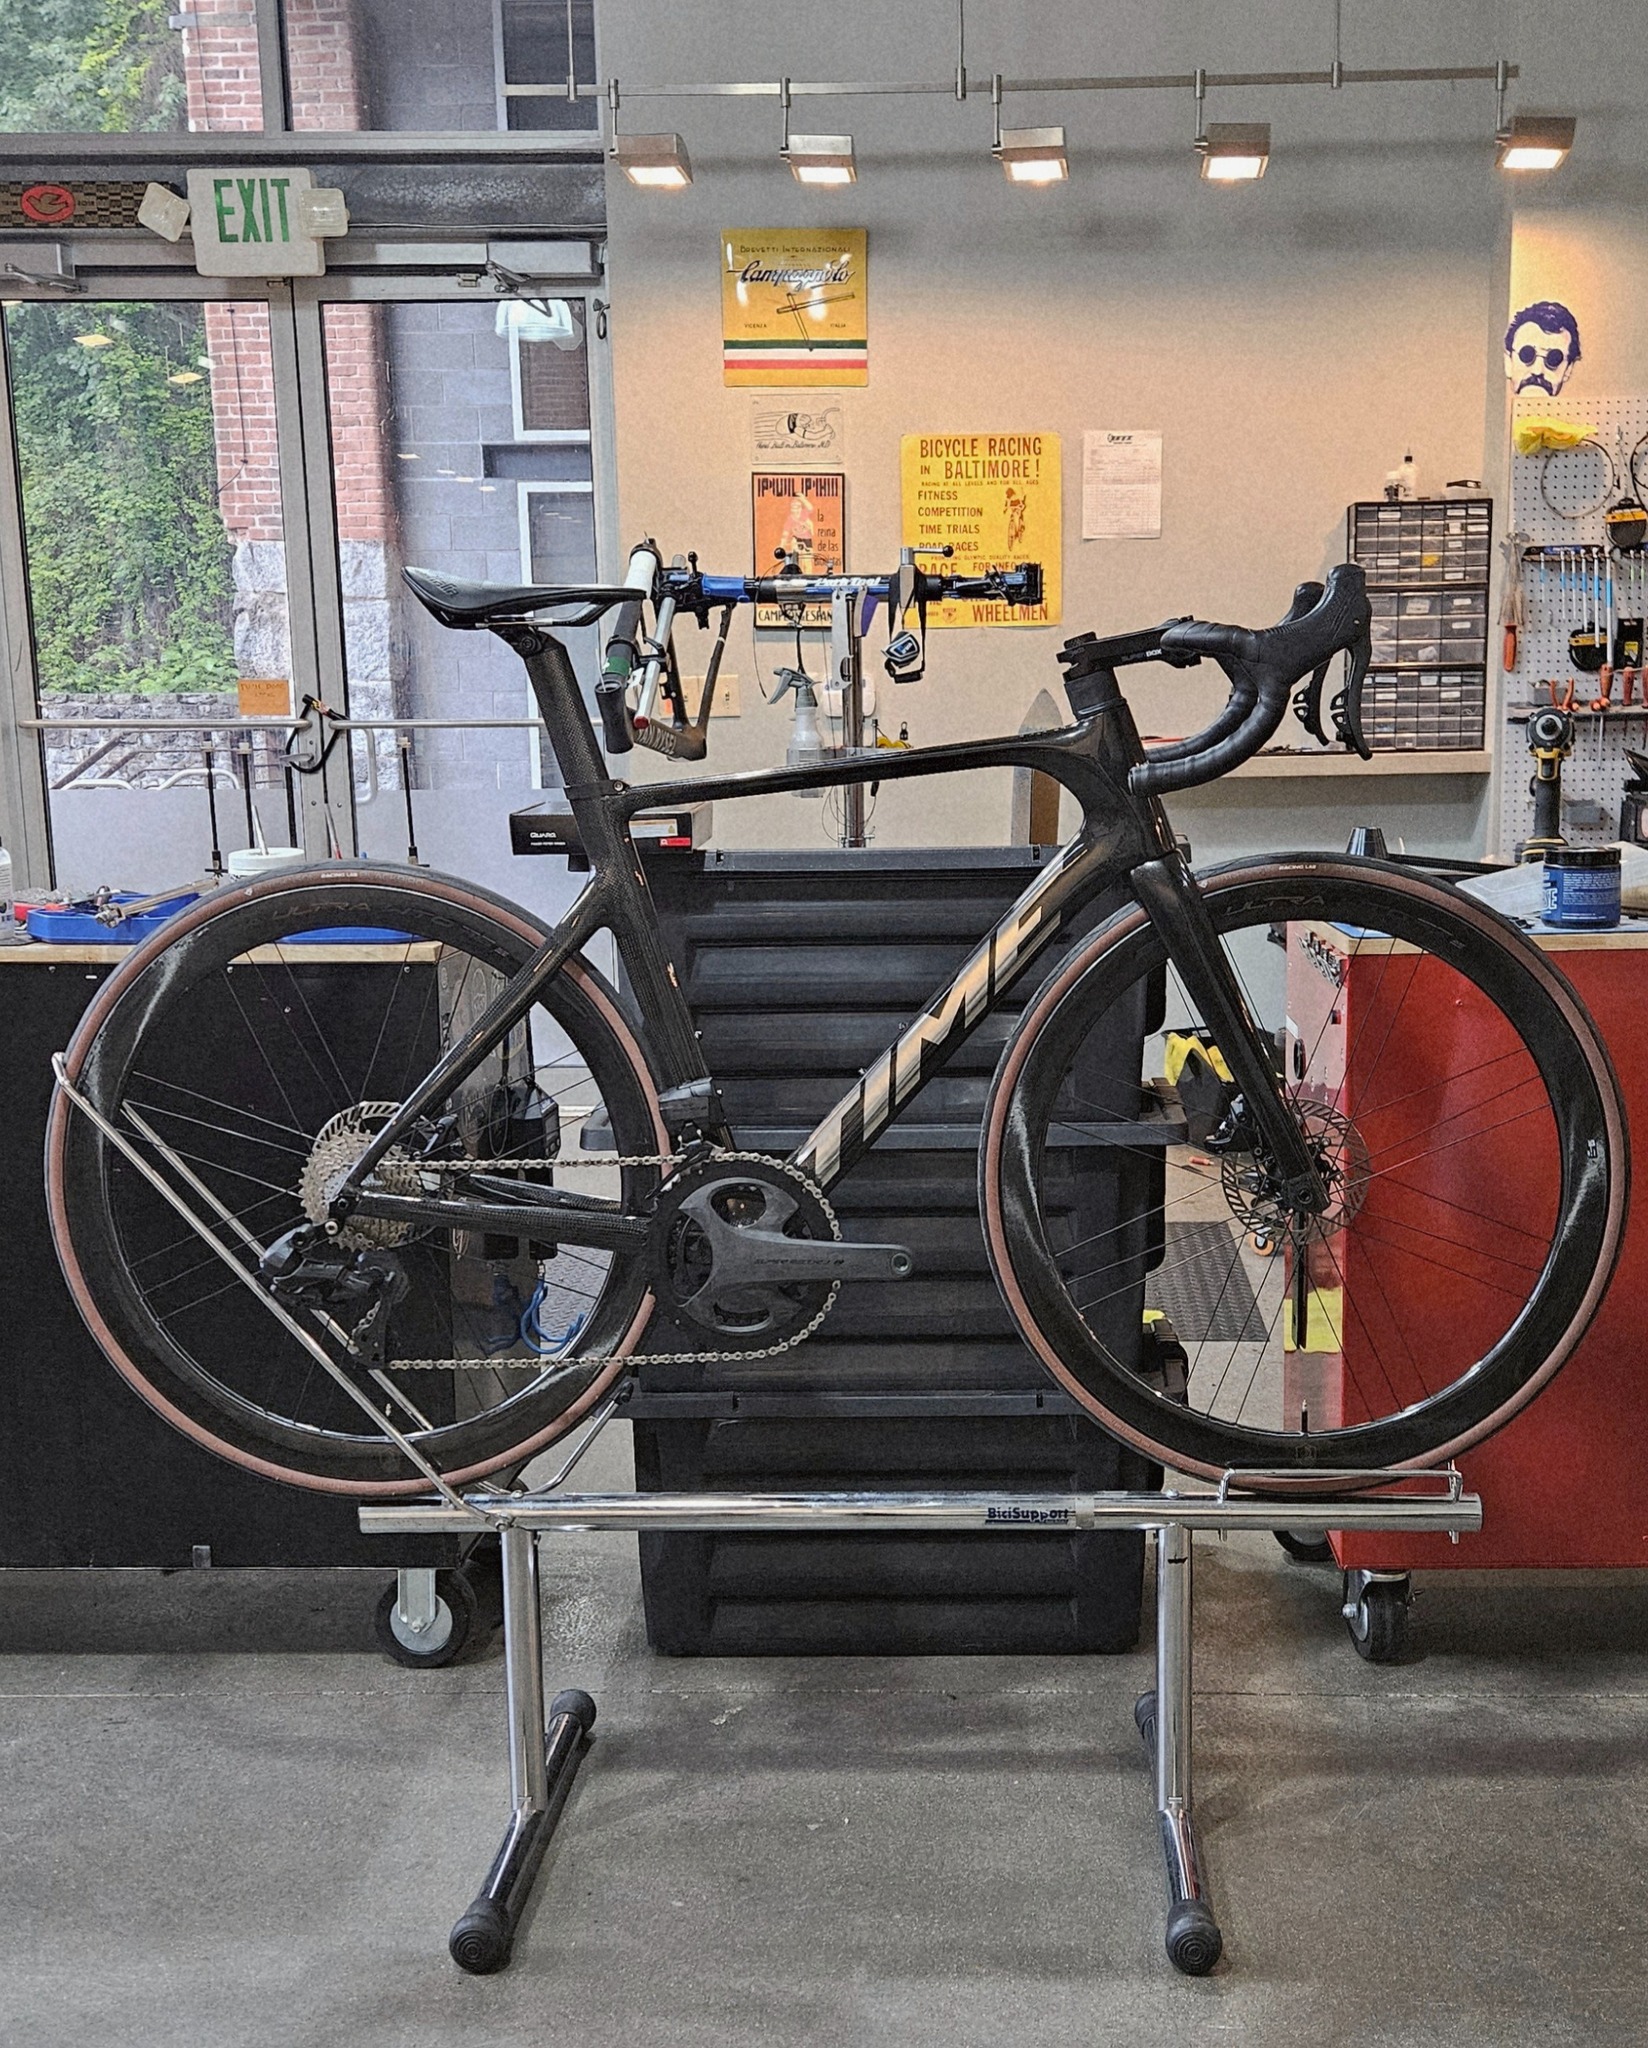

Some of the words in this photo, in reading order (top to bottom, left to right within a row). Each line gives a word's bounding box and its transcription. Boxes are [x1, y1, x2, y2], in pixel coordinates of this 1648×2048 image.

[213, 178, 290, 243] EXIT
[740, 245, 779, 253] BREVETTI
[727, 260, 856, 292] Campagnolo
[920, 438, 978, 458] BICYCLE
[988, 437, 1042, 457] RACING
[920, 465, 930, 475] IN
[918, 490, 958, 500] FITNESS
[918, 507, 983, 517] COMPETITION
[919, 524, 942, 534] TIME
[947, 524, 980, 534] TRIALS
[973, 563, 990, 571] FOR
[973, 604, 1048, 622] WHEELMEN
[987, 1507, 1069, 1520] BiciSupport
